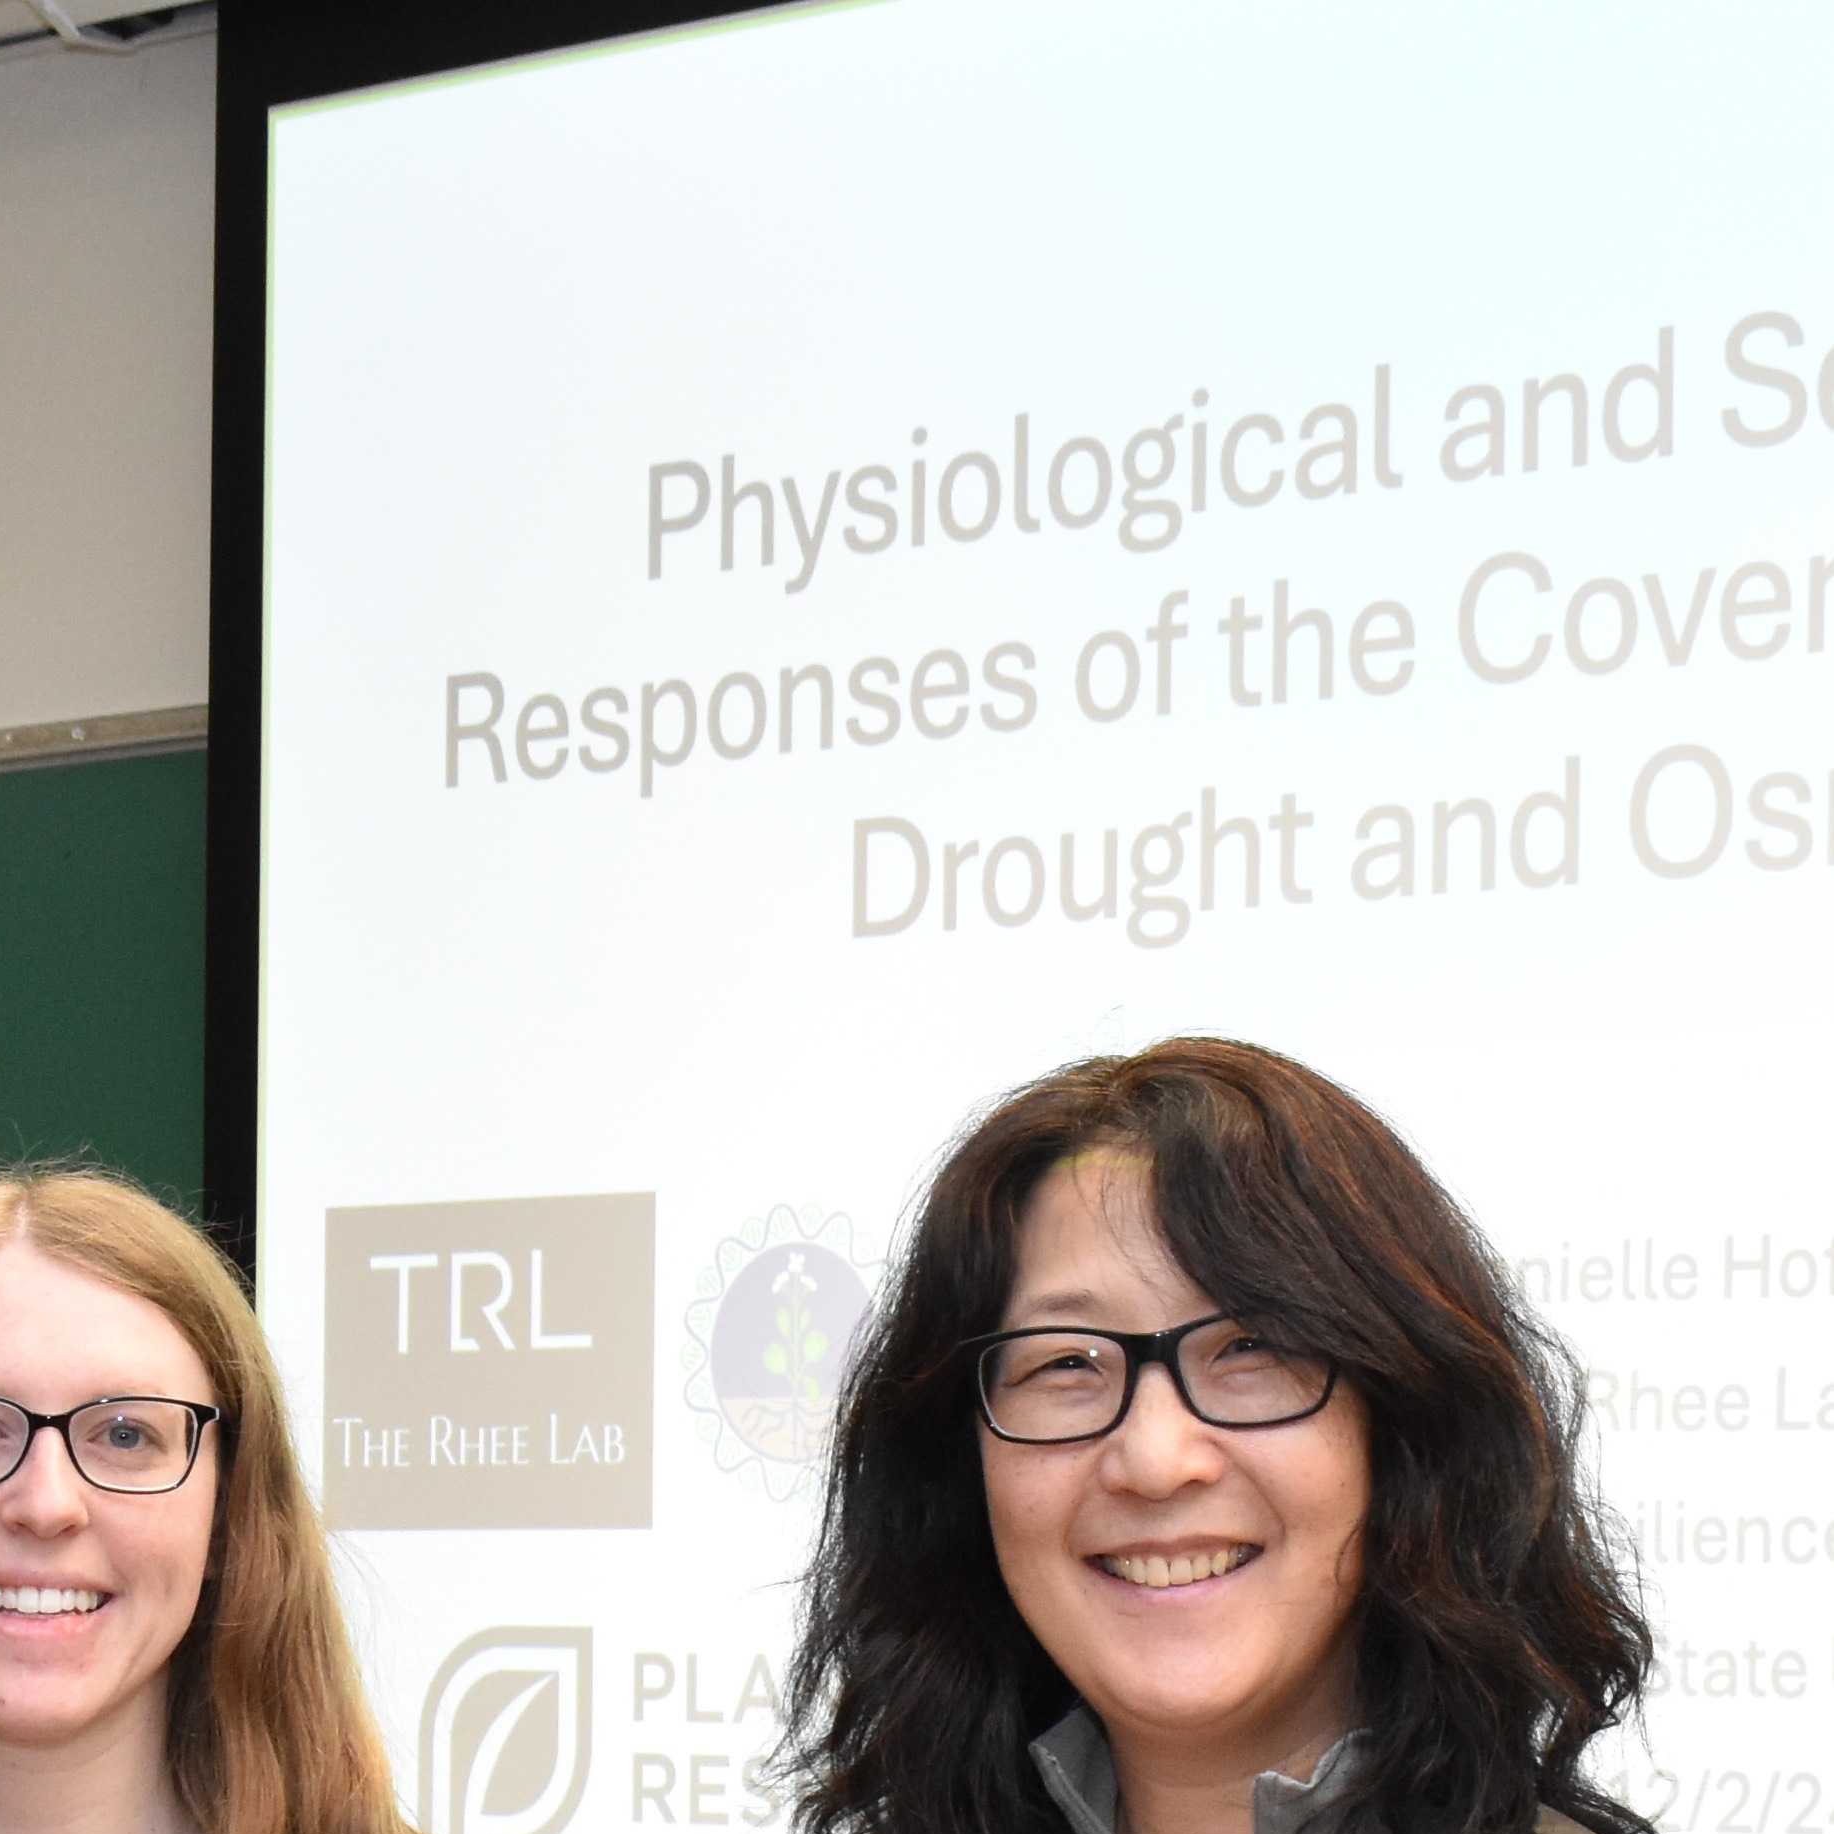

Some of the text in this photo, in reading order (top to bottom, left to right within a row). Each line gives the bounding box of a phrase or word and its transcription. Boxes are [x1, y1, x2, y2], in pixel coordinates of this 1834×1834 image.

[646, 310, 1834, 595] Physiological and S
[443, 639, 1039, 799] Responses
[1074, 588, 1189, 725] of
[1217, 578, 1418, 707] the
[851, 743, 1834, 950] Drought and Os
[369, 1247, 594, 1356] TRL
[1583, 1367, 1751, 1433] Rhee
[632, 1651, 785, 1724] PLA
